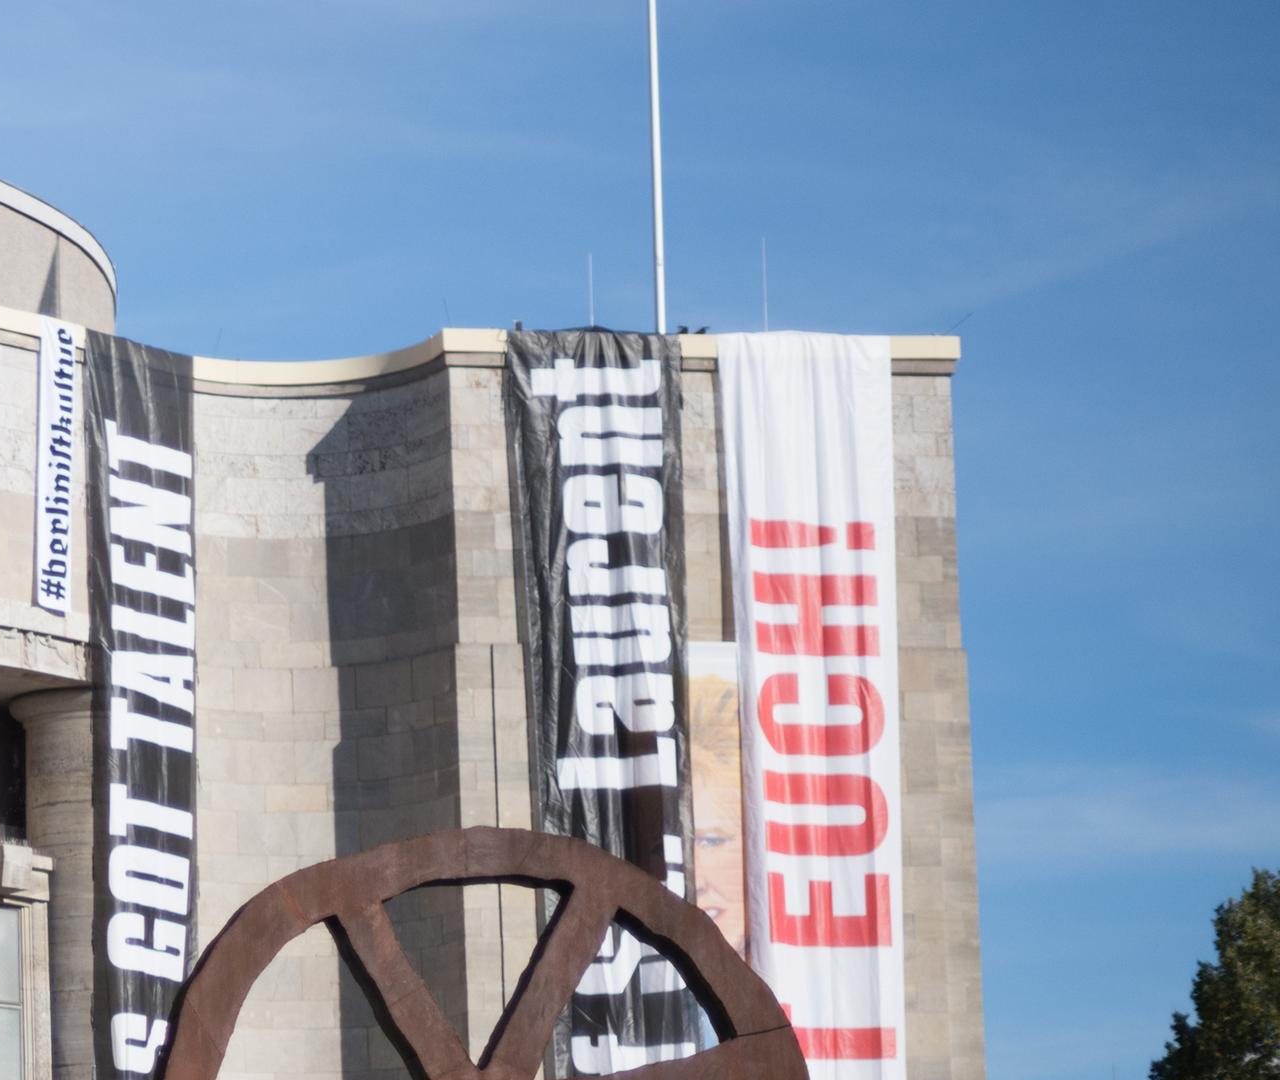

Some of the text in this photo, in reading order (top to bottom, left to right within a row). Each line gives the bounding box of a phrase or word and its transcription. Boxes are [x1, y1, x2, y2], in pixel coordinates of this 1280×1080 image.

[104, 419, 196, 752] TALENT
[529, 357, 678, 790] Laurent
[750, 516, 895, 946] EUCH!
[106, 784, 195, 982] GOT
[573, 834, 688, 995] S.
